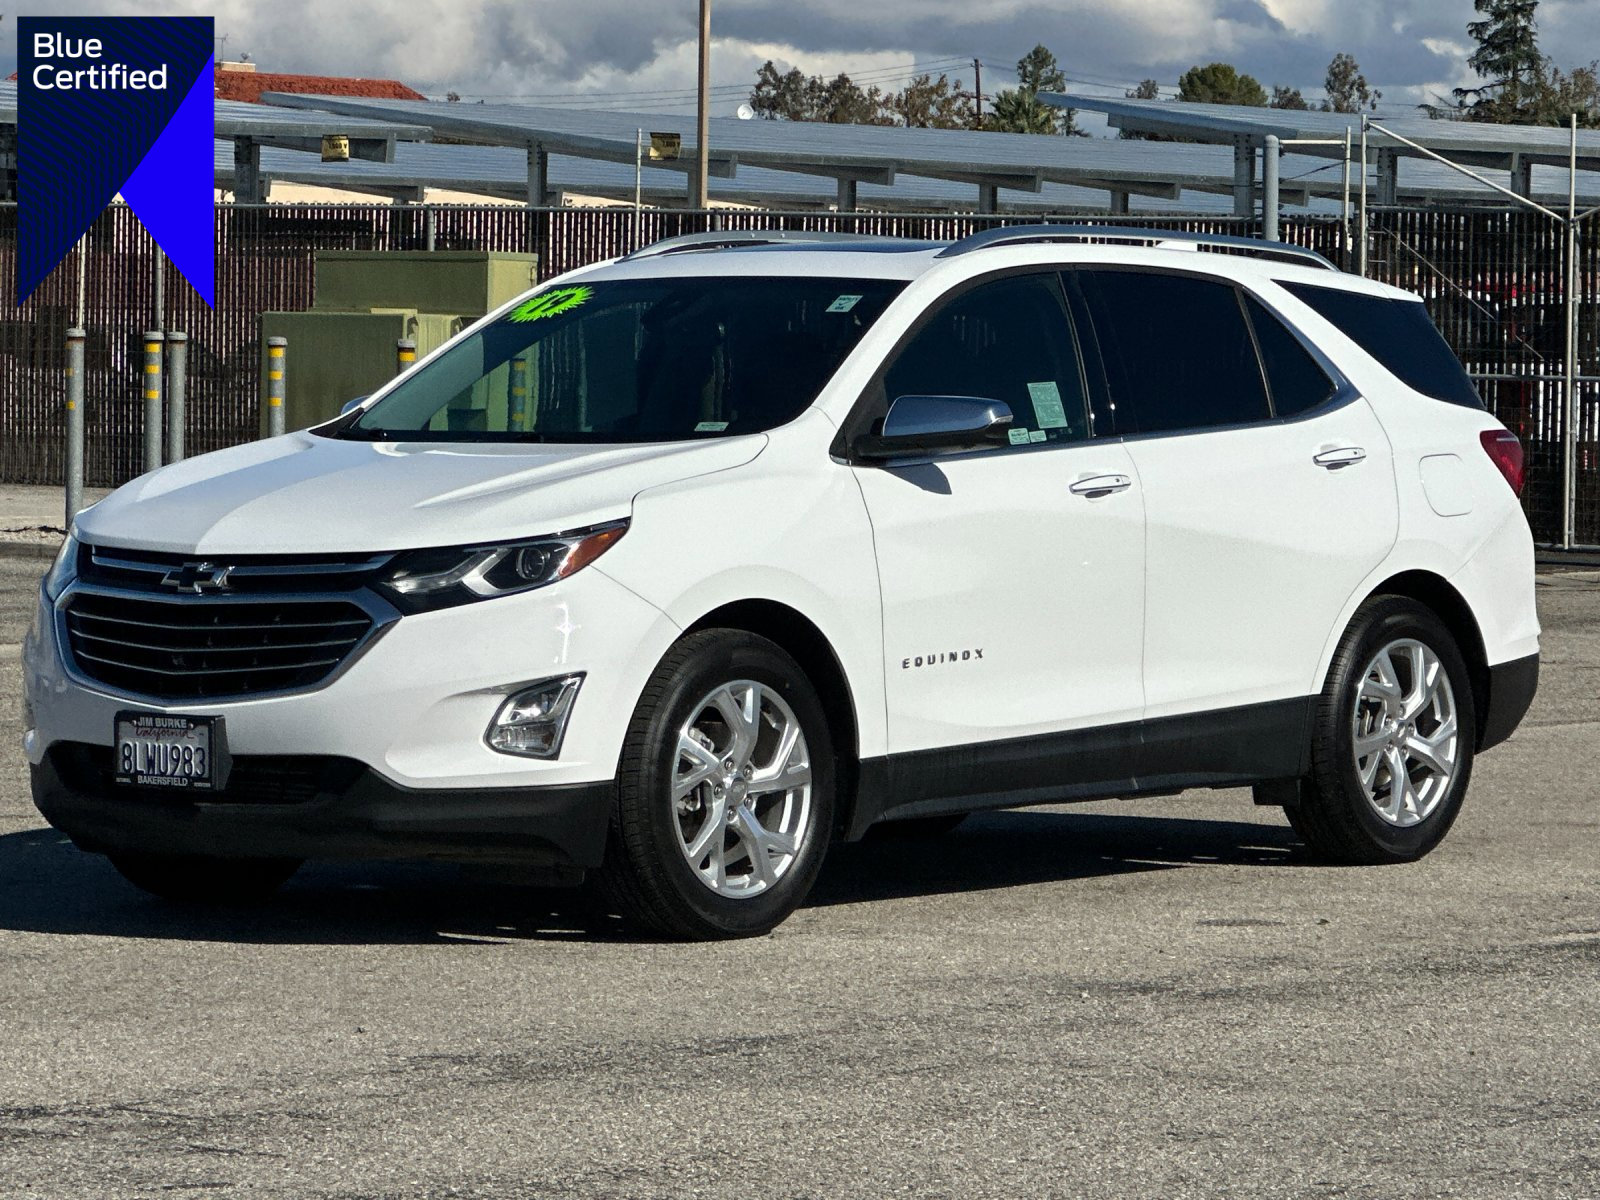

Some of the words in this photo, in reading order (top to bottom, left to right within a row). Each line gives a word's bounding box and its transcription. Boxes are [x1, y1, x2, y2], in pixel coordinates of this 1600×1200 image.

[902, 648, 983, 669] EQUINOX
[138, 717, 153, 727] JIM
[155, 718, 187, 729] BURKE
[123, 742, 206, 776] 8LWU983
[138, 775, 188, 787] BAKERSFIELD
